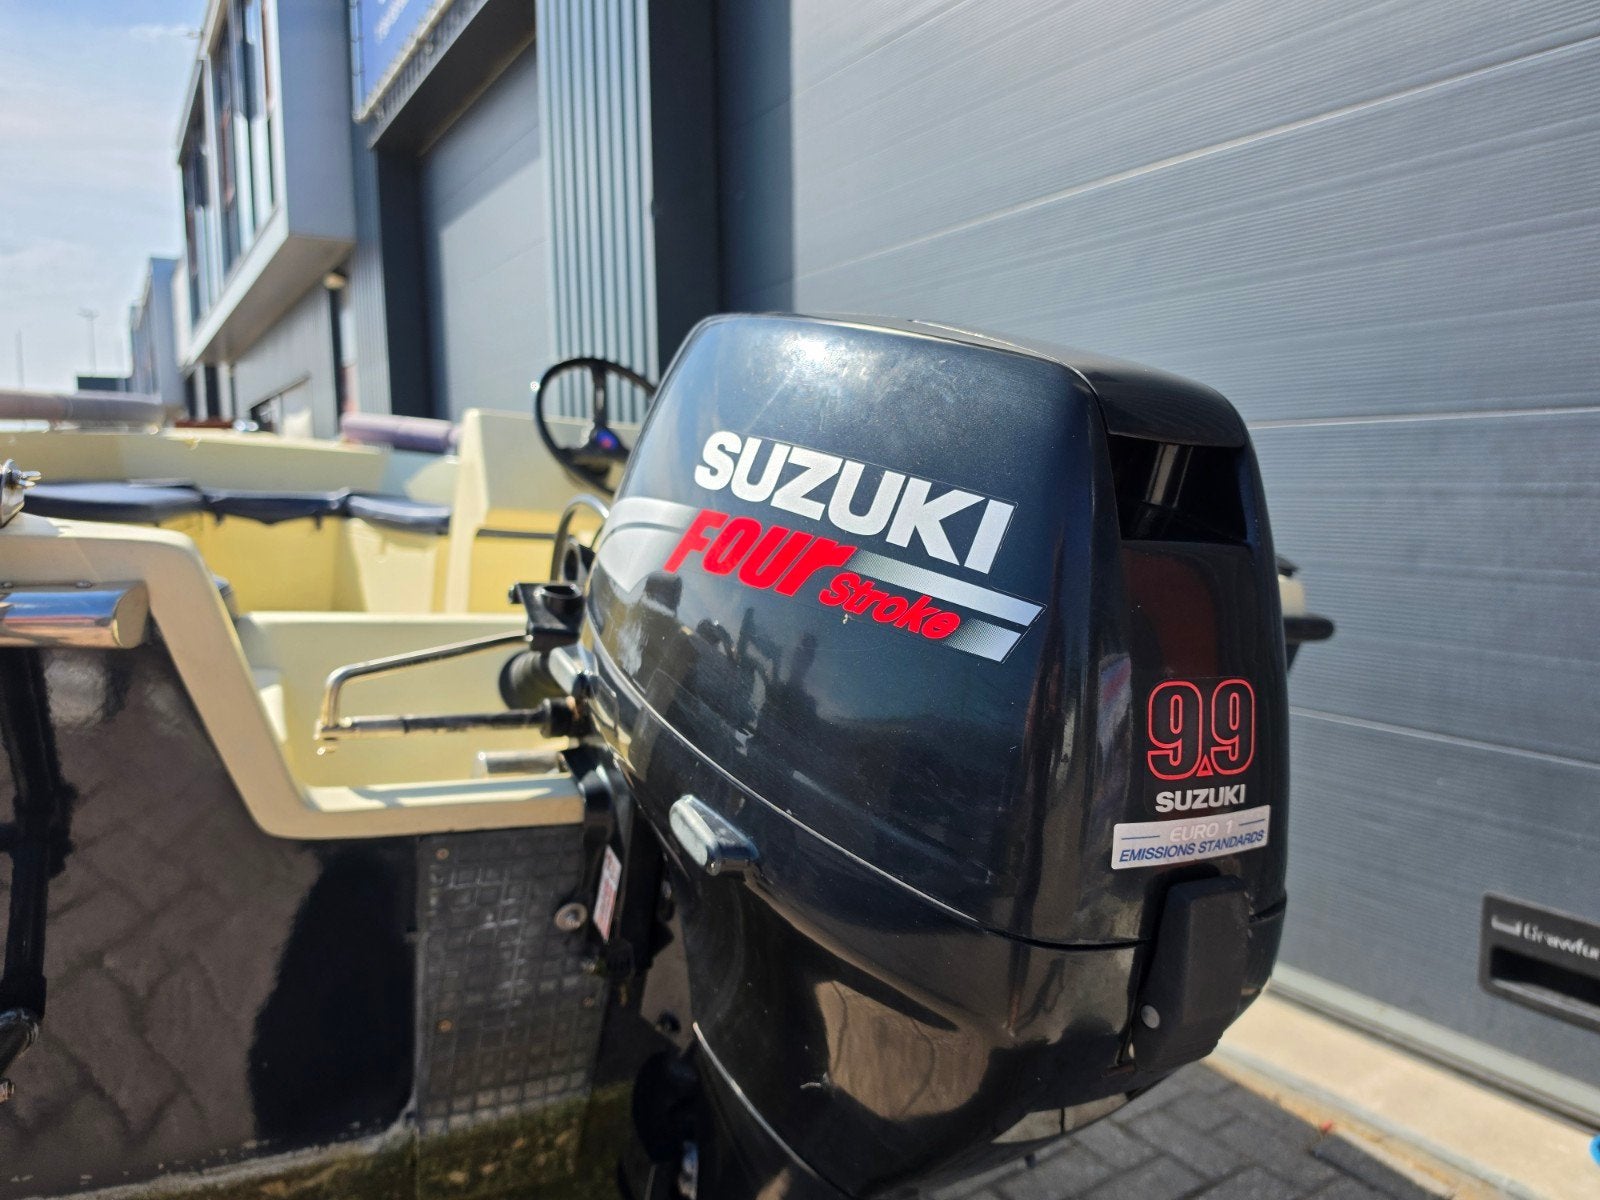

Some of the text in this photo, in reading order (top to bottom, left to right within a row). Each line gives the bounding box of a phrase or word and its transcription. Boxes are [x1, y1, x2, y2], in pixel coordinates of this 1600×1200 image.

[694, 430, 1015, 574] SUZUKI
[818, 571, 961, 640] Stroke
[1155, 784, 1246, 813] SUZUKI
[1119, 829, 1265, 862] EMISSIONS STANDARDS
[1169, 819, 1234, 842] EURO 1
